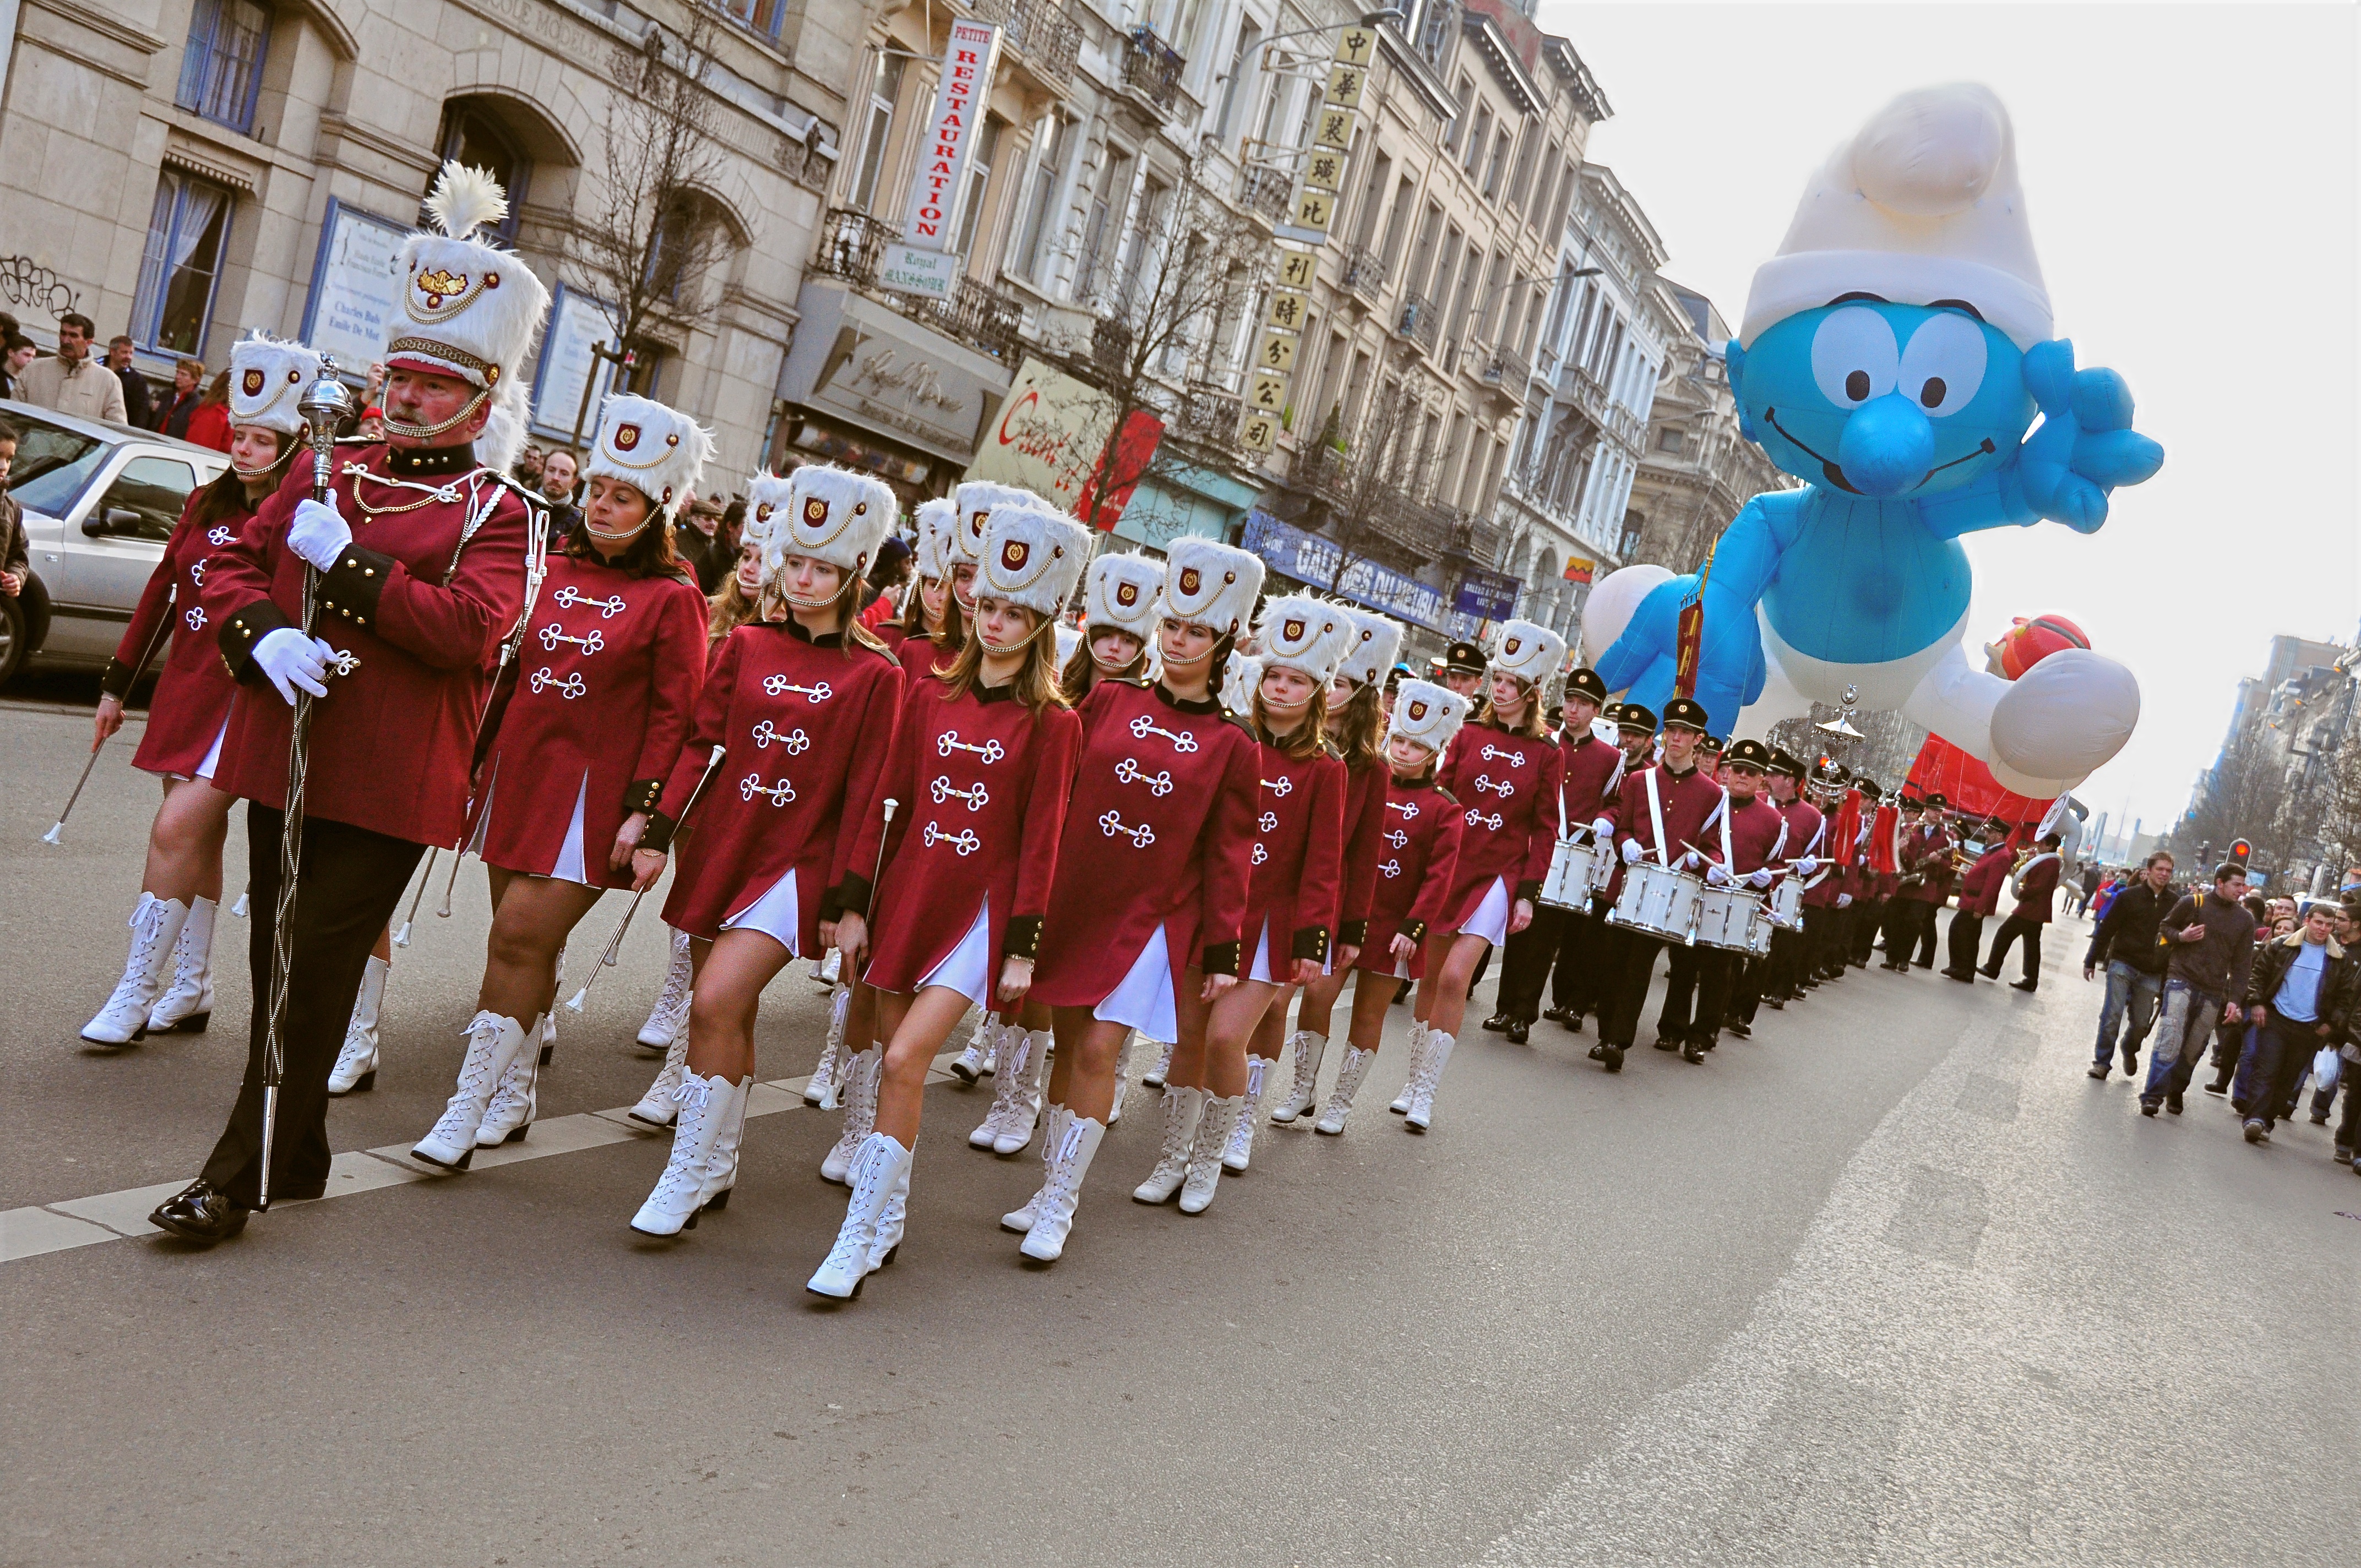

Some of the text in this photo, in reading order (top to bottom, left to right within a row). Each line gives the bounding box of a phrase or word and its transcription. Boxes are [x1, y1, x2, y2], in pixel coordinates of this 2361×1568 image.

[954, 25, 991, 43] PETITE
[916, 49, 978, 237] RESTAURATION
[905, 252, 937, 270] Royal
[1372, 571, 1395, 606] DU
[1392, 578, 1444, 625] MEUBLE
